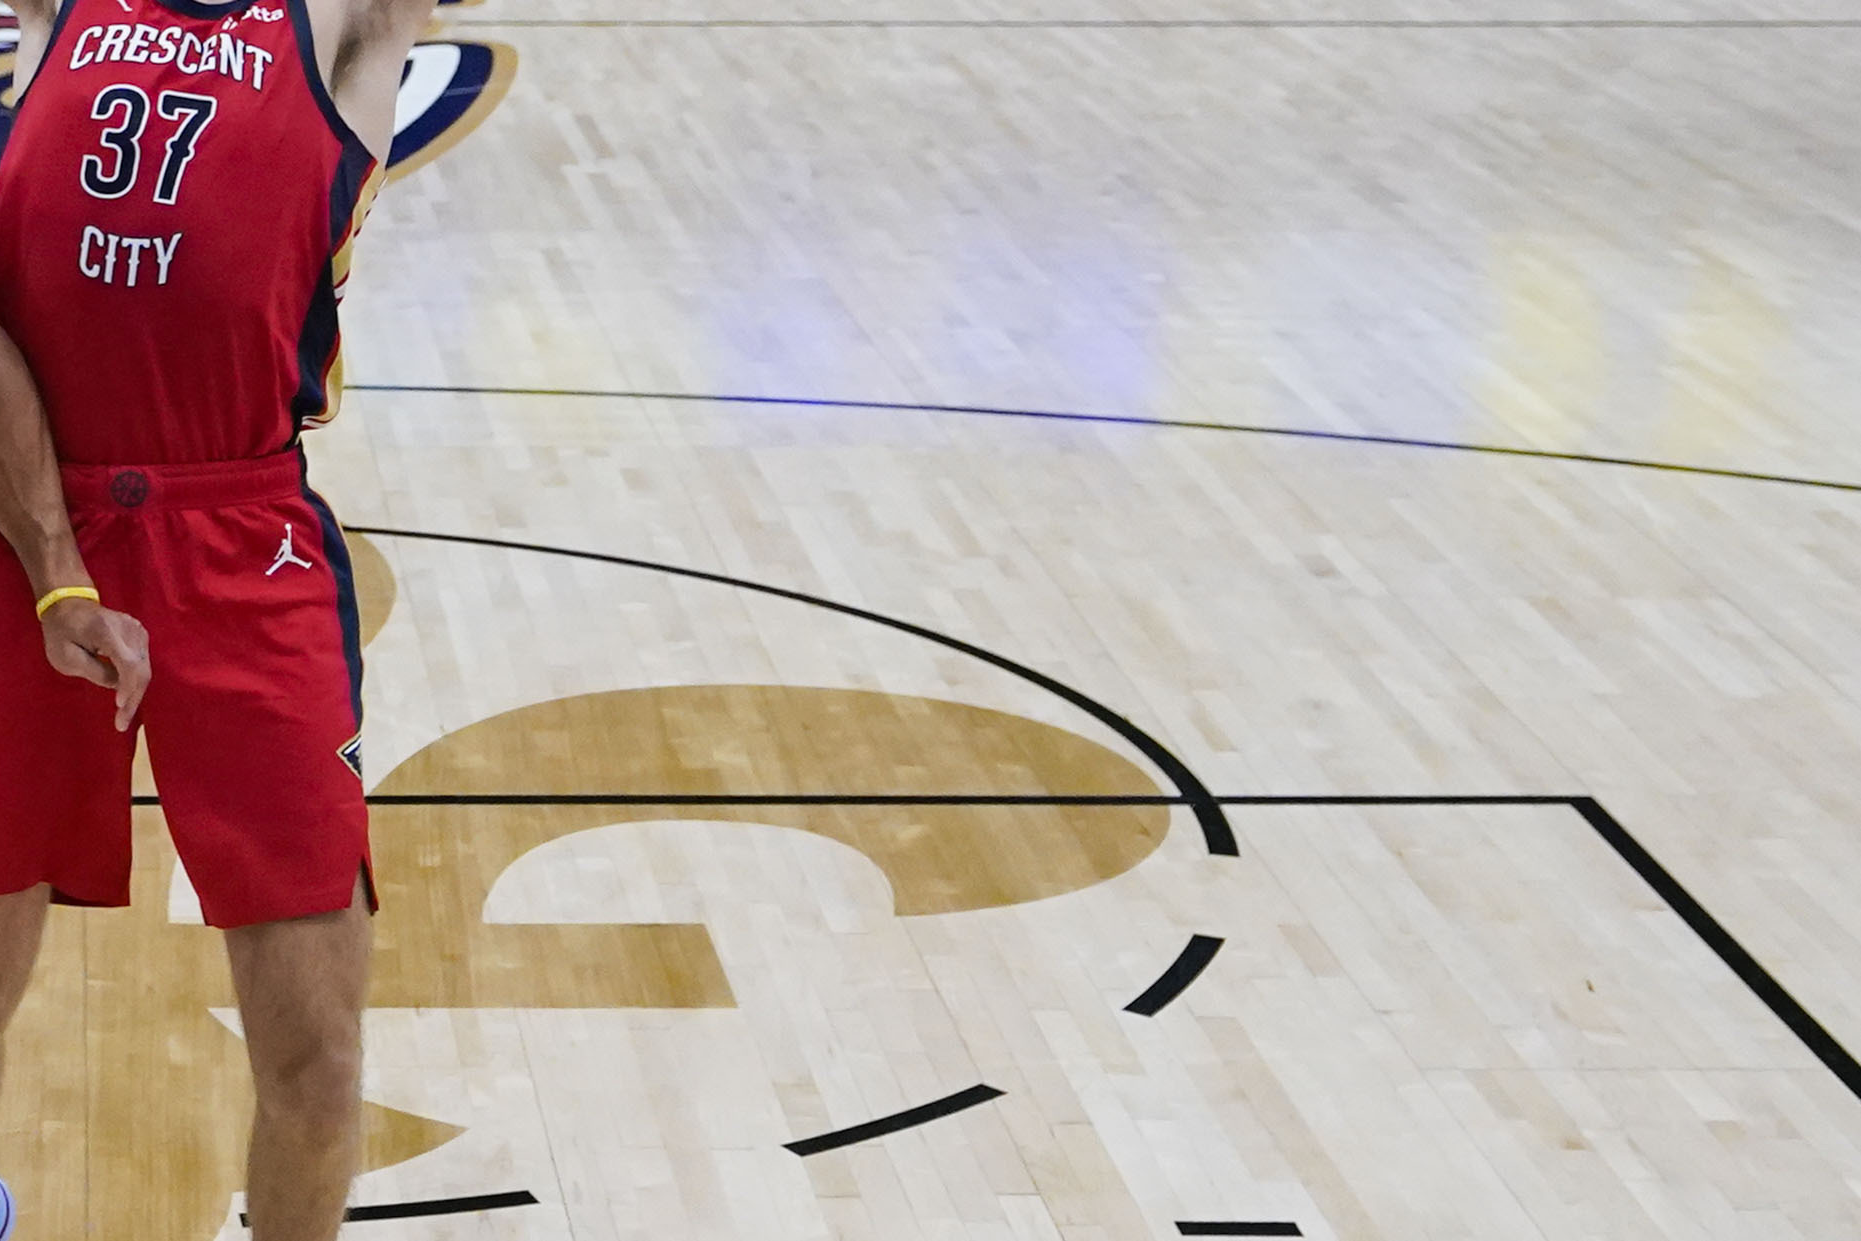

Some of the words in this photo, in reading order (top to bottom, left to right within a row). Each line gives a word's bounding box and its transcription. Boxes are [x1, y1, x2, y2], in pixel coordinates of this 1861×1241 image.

[69, 24, 273, 91] CRESCENT
[79, 83, 218, 206] 37
[78, 225, 183, 288] CITY
